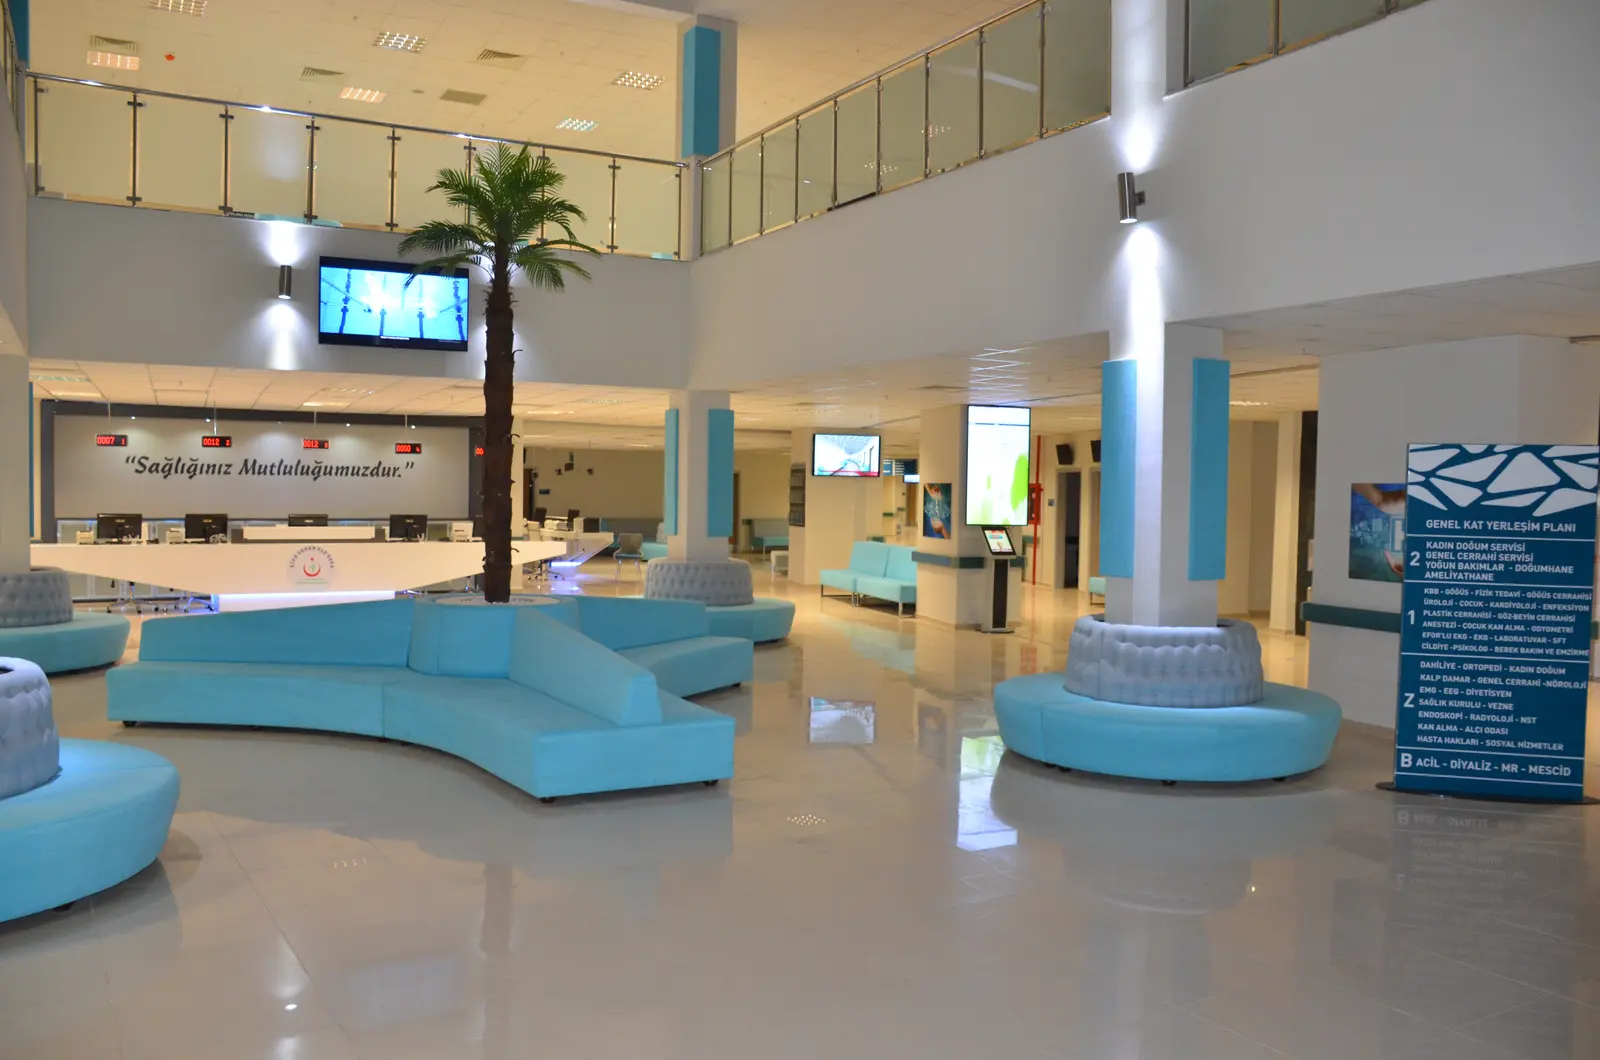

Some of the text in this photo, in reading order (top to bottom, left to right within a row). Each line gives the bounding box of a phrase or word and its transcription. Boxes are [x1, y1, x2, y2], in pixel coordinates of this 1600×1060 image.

[203, 437, 220, 446] 0012
[303, 439, 319, 448] 0012
[1426, 520, 1576, 533] GENEL KAT YERLEŞİM PLANI
[1426, 541, 1525, 552] KADIN DOĞUM SERVİSİ
[1410, 551, 1420, 566] 2
[1426, 551, 1533, 562] GENEL CERRAHİ SERVİSİ
[1425, 560, 1456, 569] YOĞUN
[1458, 562, 1504, 571] BAKIMLAR
[1515, 563, 1573, 574] DOĞUMHANE
[1424, 570, 1494, 581] AMELİYATHANE
[1526, 591, 1552, 599] GÖĞÜS
[1424, 598, 1454, 606] ÜROLOJİ
[1489, 601, 1536, 609] KARDİYOLOJİ
[1543, 604, 1589, 612] ENFEKSİYON
[1408, 610, 1415, 625] 1
[1421, 642, 1448, 650] CİLDİYE
[1420, 661, 1456, 670] DAHİLİYE
[1463, 663, 1502, 672] ORTOPEDİ
[1536, 666, 1566, 675] DOĞUM
[1442, 675, 1471, 683] DAMAR
[1505, 678, 1541, 686] CERRAHİ
[1466, 688, 1512, 698] DİYETİSYEN
[1404, 693, 1415, 708] Z
[1419, 698, 1447, 706] SAĞLIK
[1448, 700, 1481, 708] KURULU
[1488, 702, 1513, 710] VEZNE
[1418, 711, 1463, 720] ENDOSKOPİ
[1470, 714, 1513, 723] RADYOLOJİ
[1444, 737, 1479, 746] HAKLARI
[1485, 740, 1516, 748] SOSYAL
[1517, 740, 1564, 750] HİZMETLER
[1401, 753, 1412, 768] B
[1416, 756, 1440, 768] ACİL
[1450, 758, 1491, 771] DİYALİZ
[1501, 763, 1518, 773] MR
[1528, 765, 1571, 776] MESCİD
